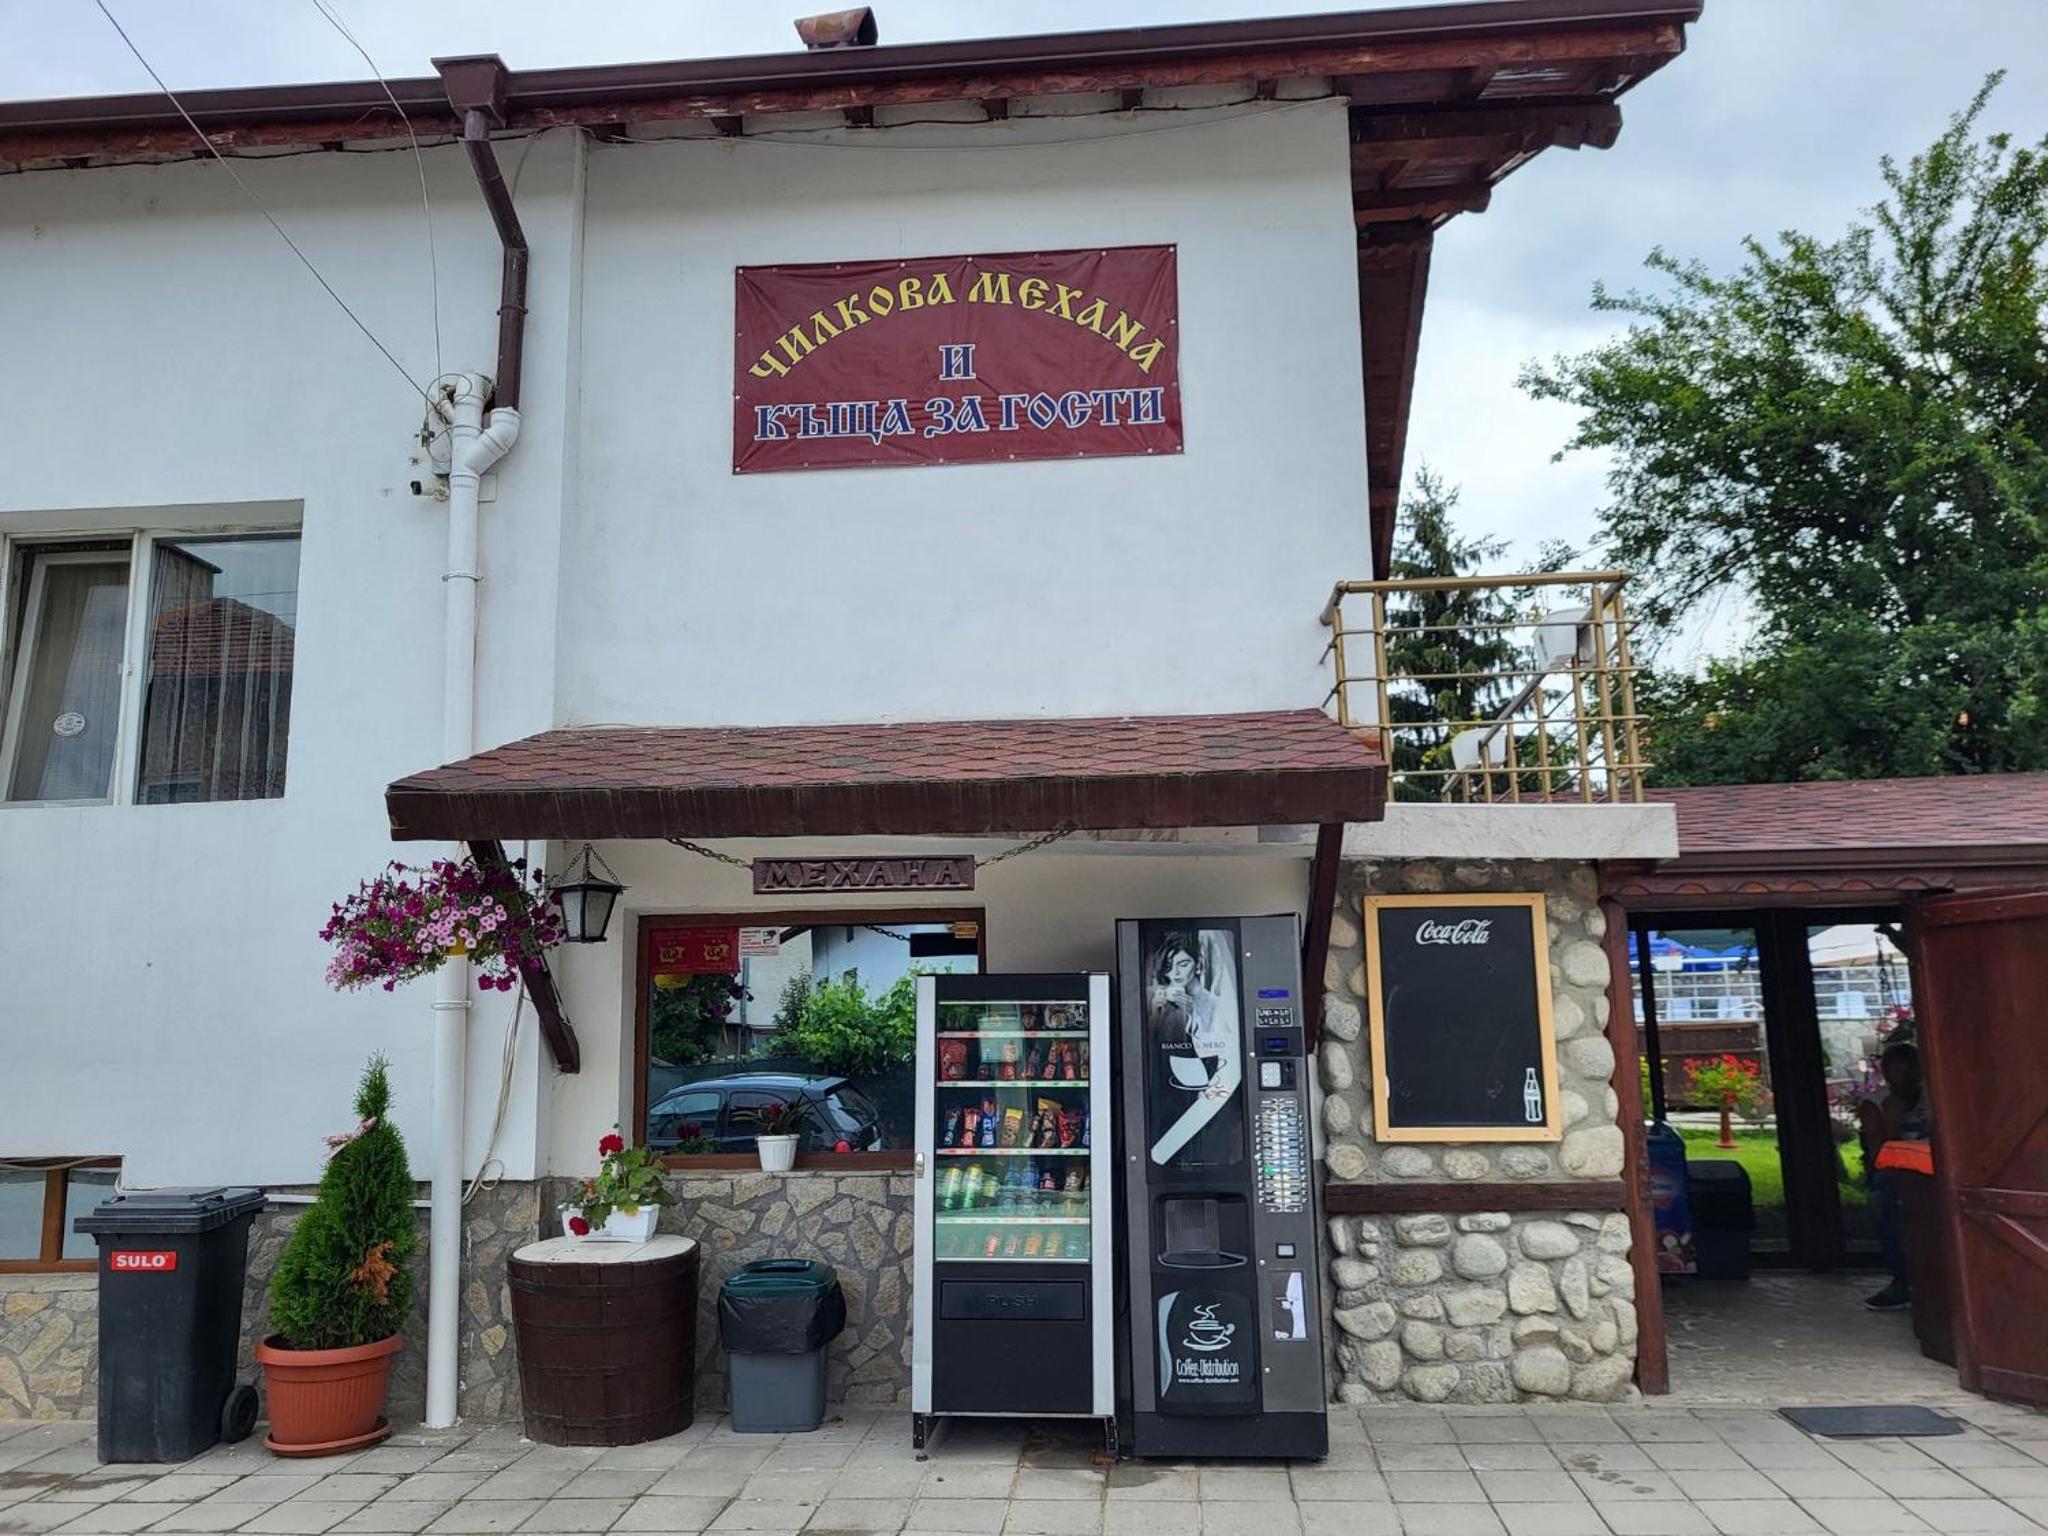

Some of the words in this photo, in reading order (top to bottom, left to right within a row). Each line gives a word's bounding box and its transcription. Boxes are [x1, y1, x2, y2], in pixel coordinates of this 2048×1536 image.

[749, 272, 957, 381] ЧИЛКОВА
[939, 343, 976, 381] И
[754, 399, 915, 445] КЪЩА
[924, 396, 989, 438] ЗА
[1000, 387, 1166, 430] ГОСТИ
[764, 860, 963, 888] МЕХАНА
[1416, 919, 1493, 945] Coca-Cola
[116, 1254, 166, 1268] SULO
